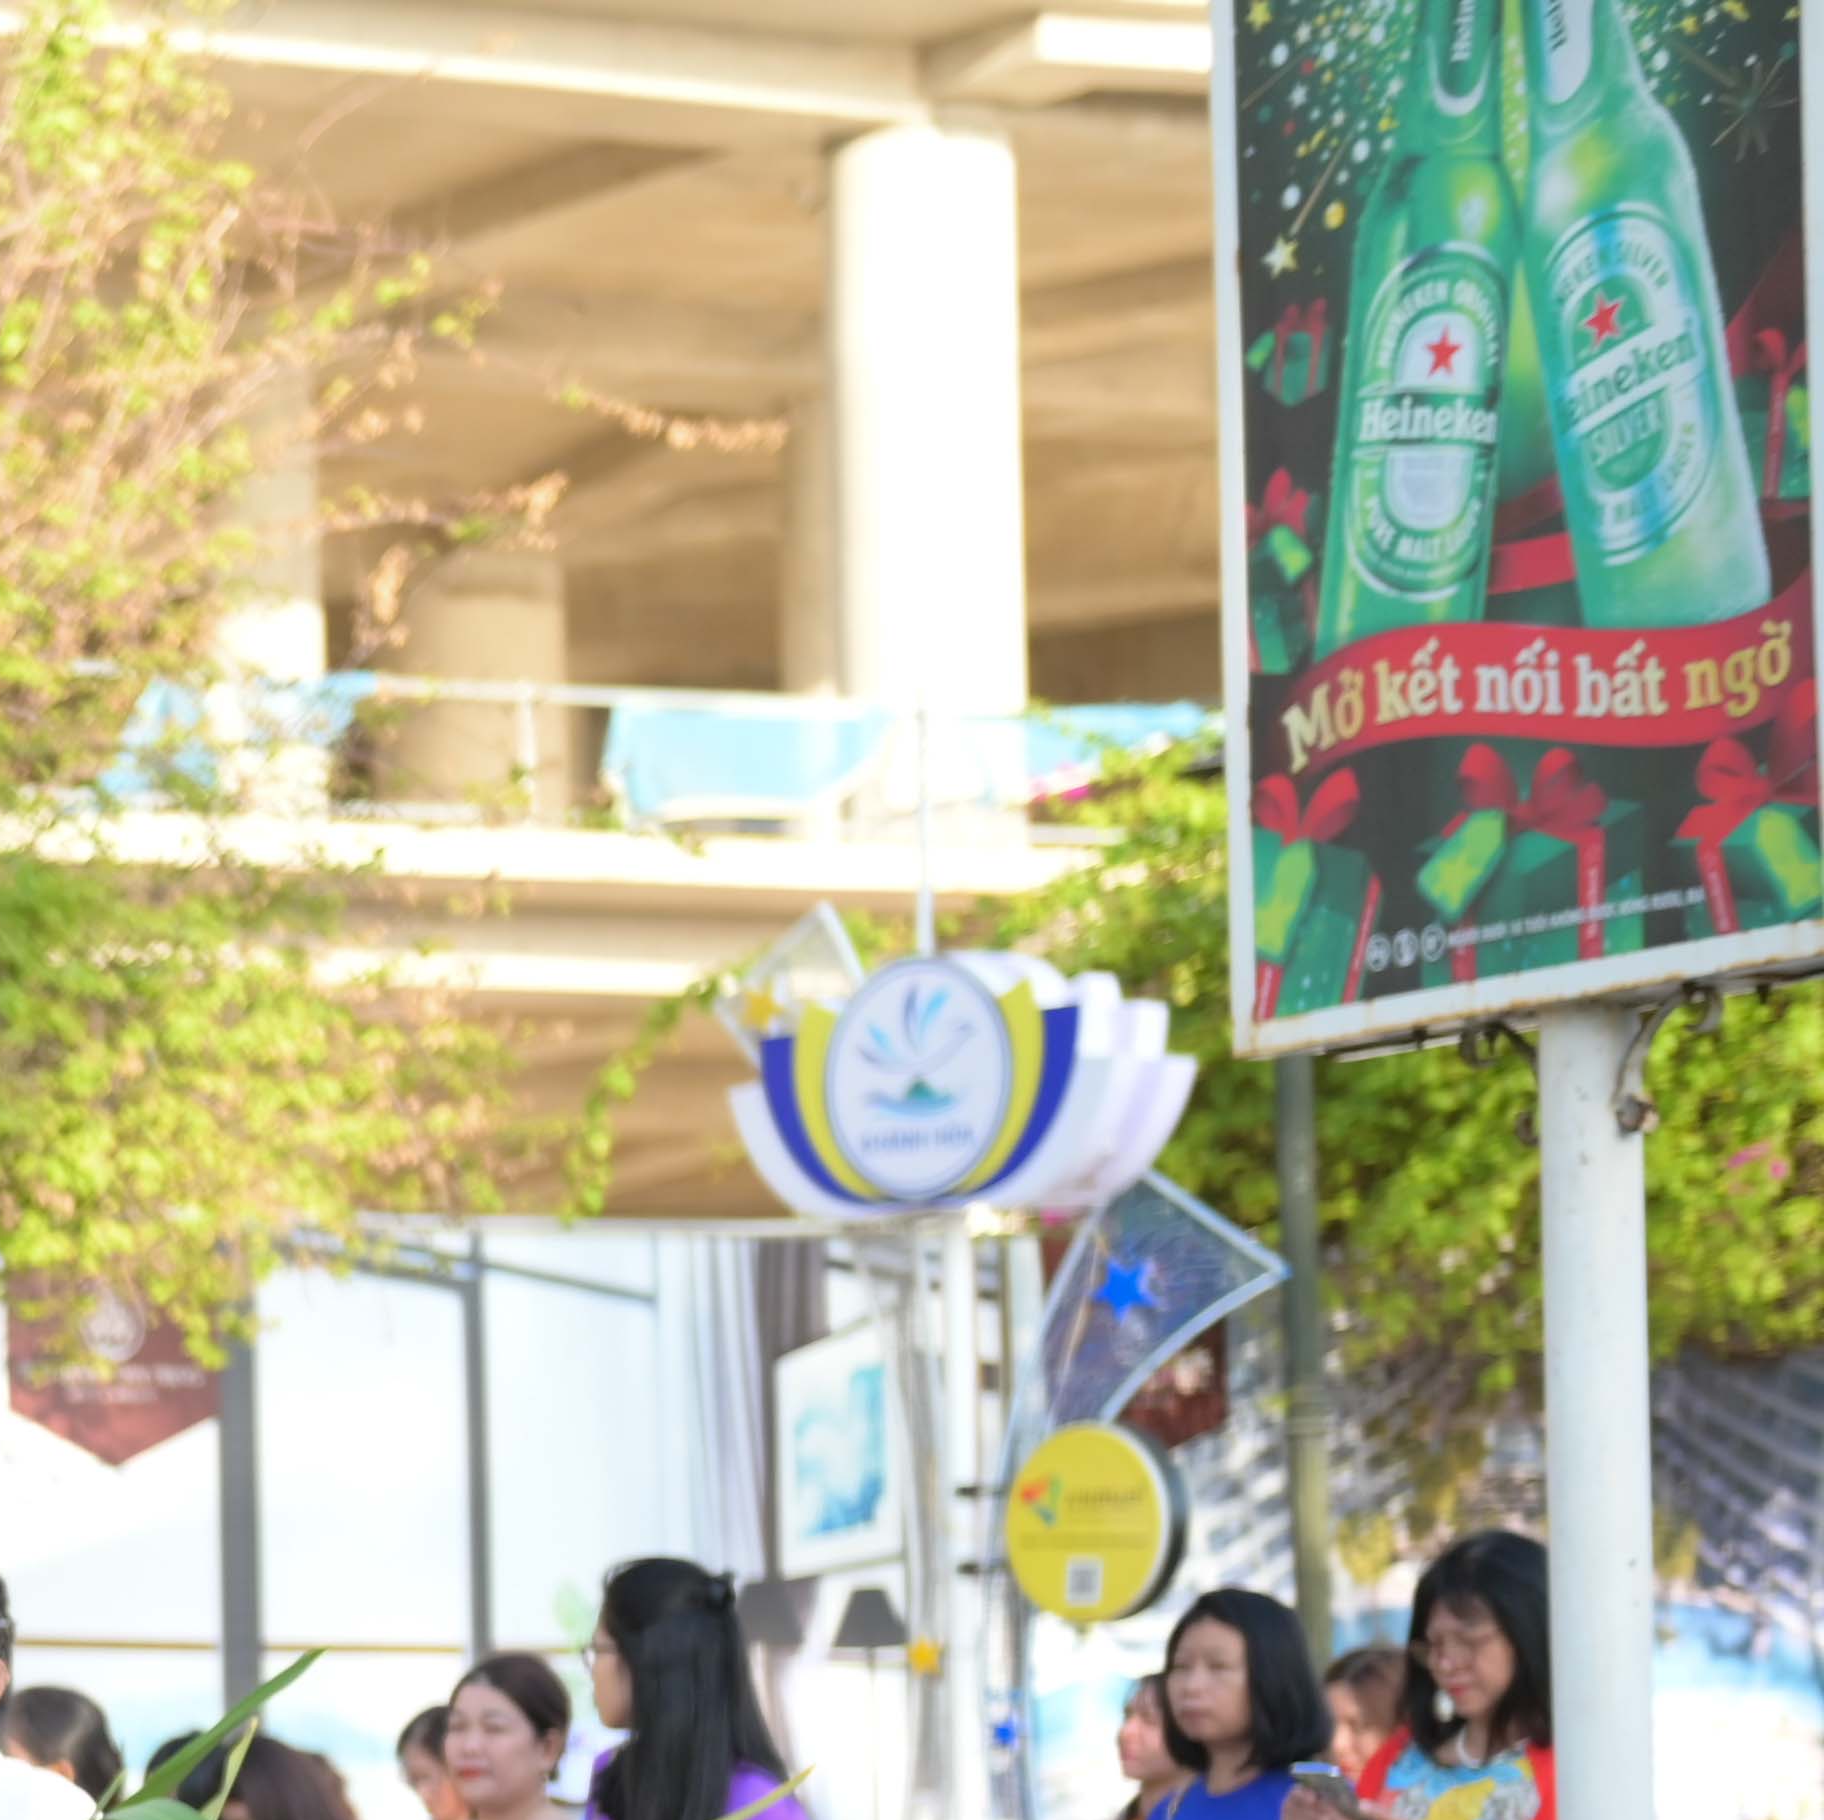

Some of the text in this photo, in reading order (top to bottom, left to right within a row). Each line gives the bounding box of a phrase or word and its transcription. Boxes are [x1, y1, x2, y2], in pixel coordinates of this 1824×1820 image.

[1280, 618, 1793, 775] Mở kết nối bất ngờ
